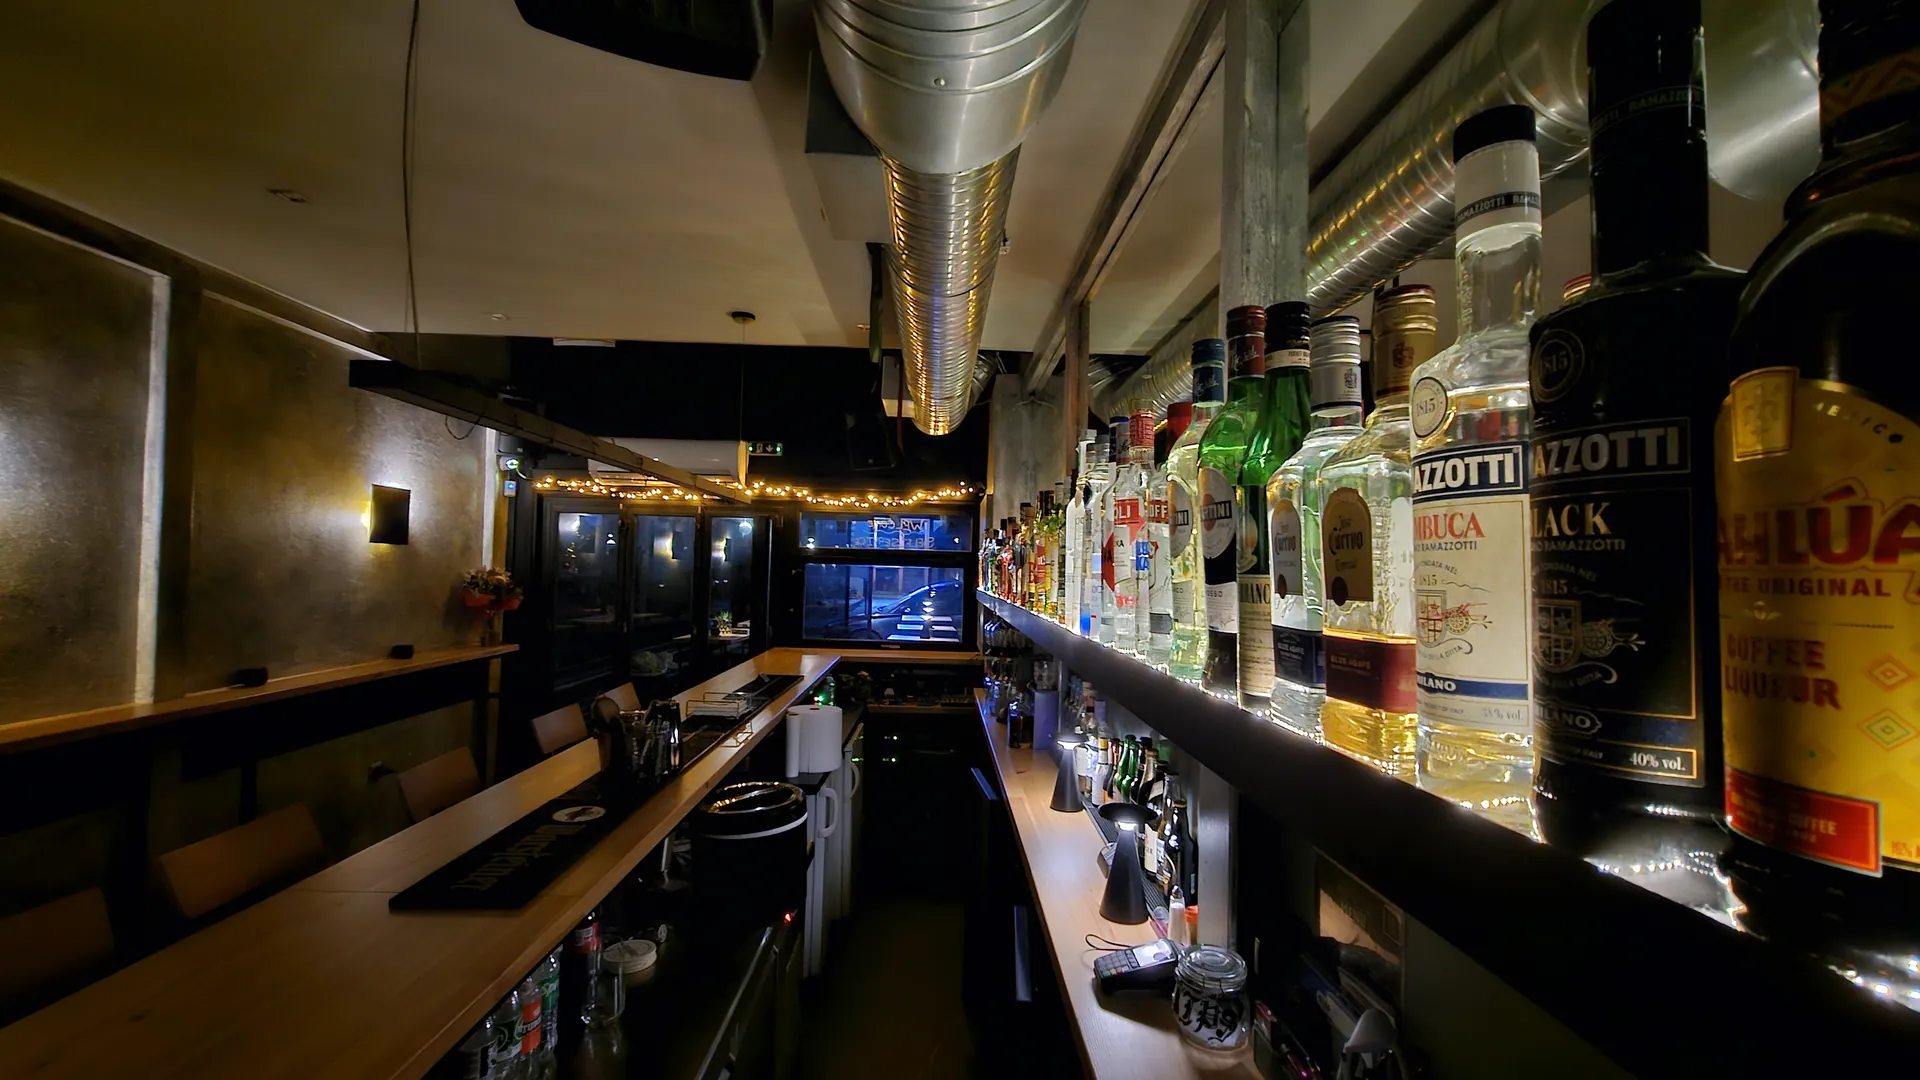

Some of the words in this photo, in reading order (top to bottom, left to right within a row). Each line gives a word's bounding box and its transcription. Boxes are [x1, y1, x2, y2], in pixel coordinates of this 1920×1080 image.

[1415, 397, 1436, 418] 1815
[1413, 453, 1515, 493] AZZOTTI
[1758, 577, 1891, 597] ORIGINAL
[1726, 633, 1826, 670] COFFEE
[1725, 664, 1842, 709] LIQUEUR
[1629, 751, 1660, 768] 40%
[1661, 757, 1686, 771] vol.
